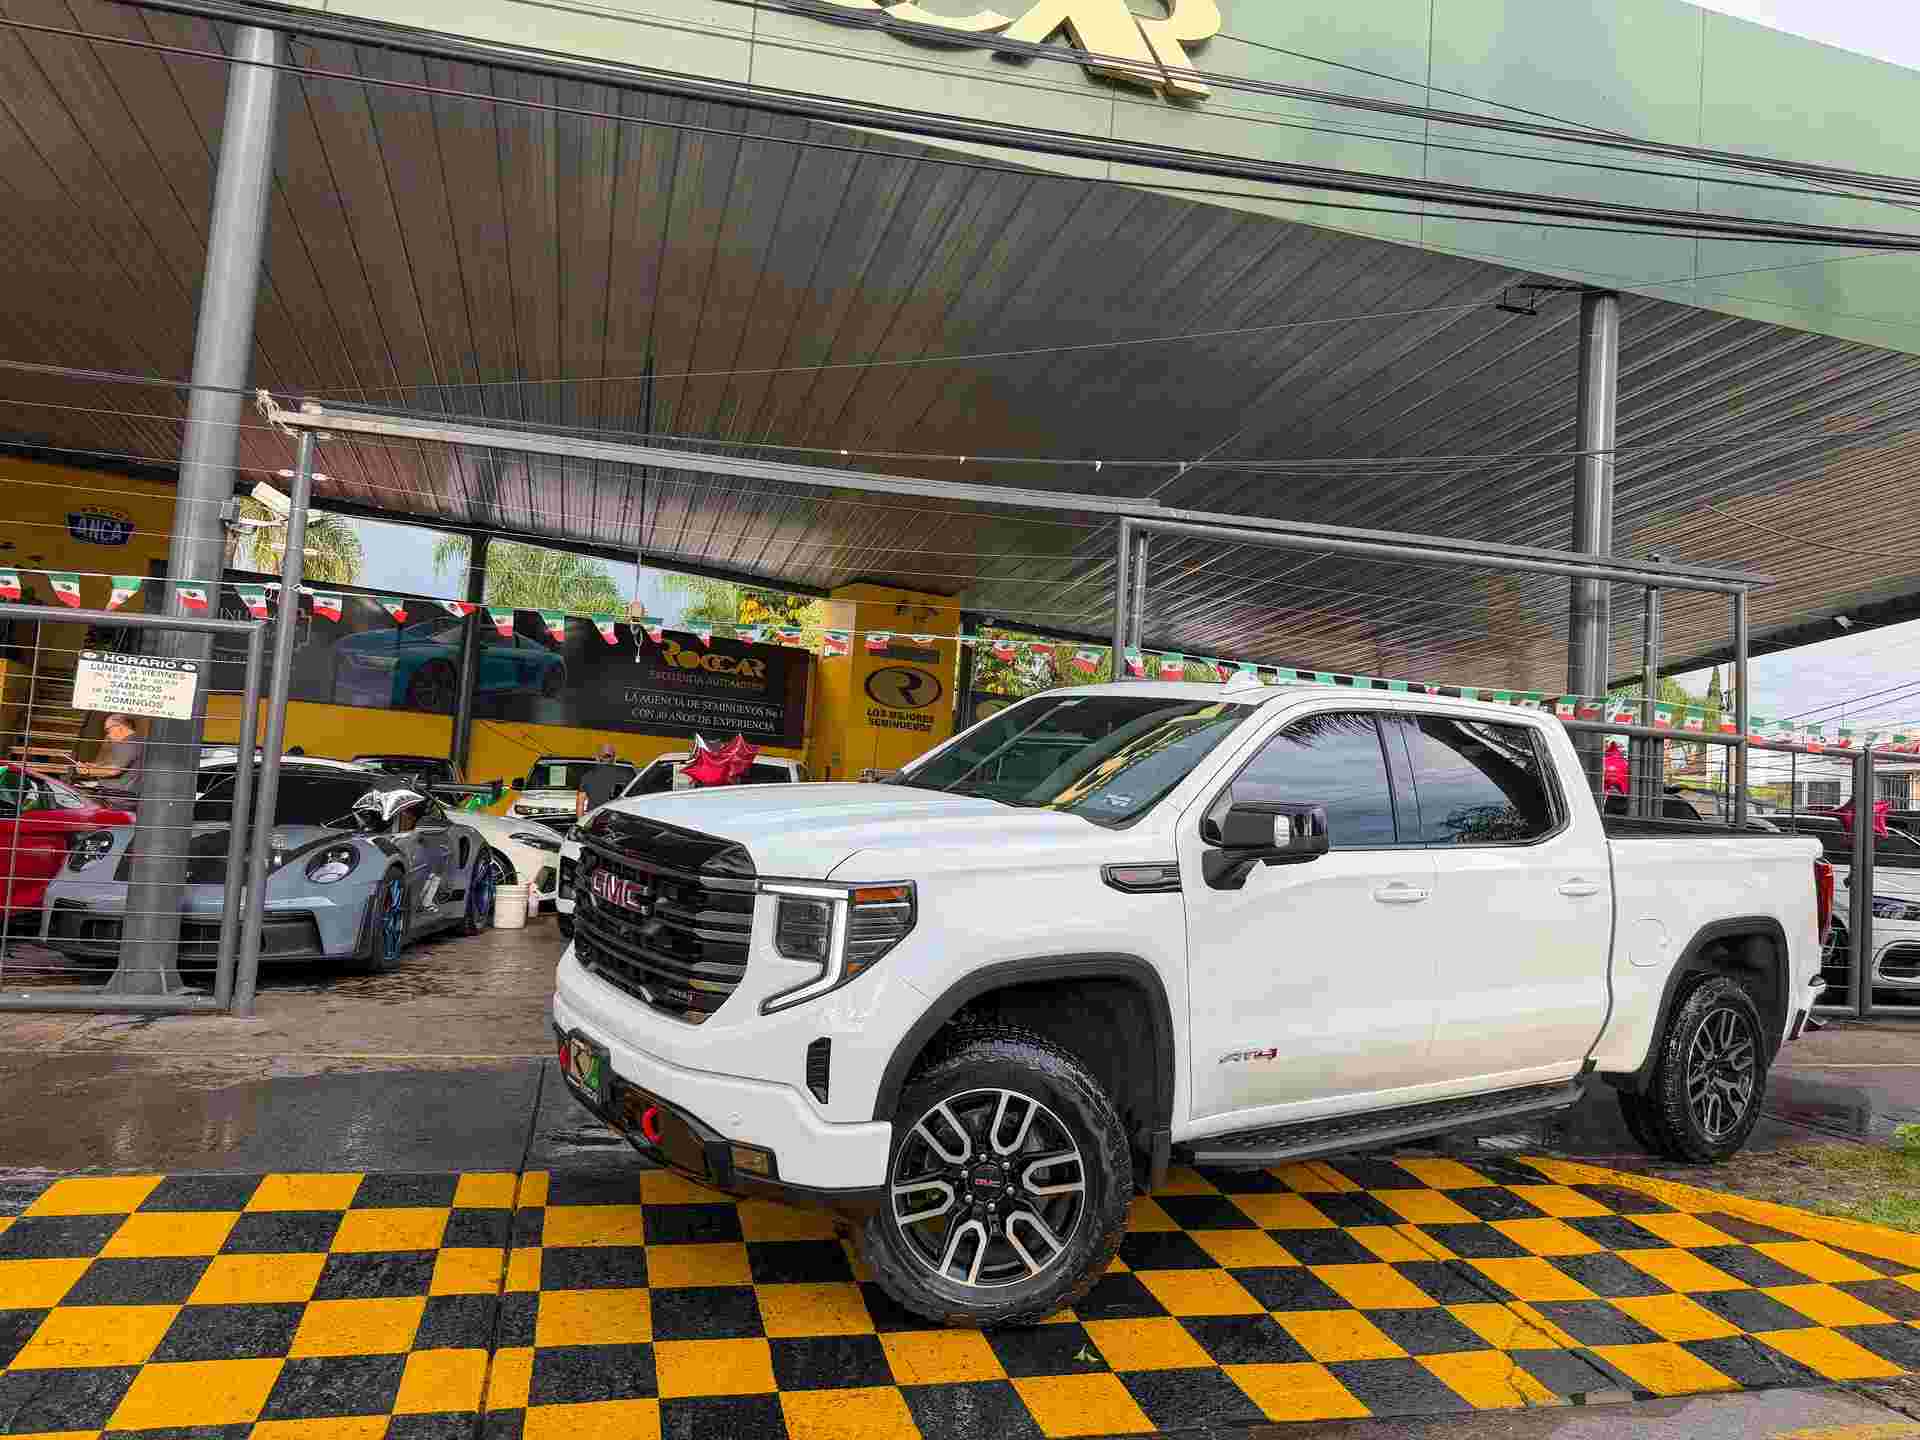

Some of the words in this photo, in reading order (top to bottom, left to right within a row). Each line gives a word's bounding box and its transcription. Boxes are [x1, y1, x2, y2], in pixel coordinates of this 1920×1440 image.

[89, 662, 127, 674] LUNES
[103, 653, 178, 669] HORARIO
[103, 695, 165, 709] DOMINGOS
[632, 707, 653, 720] CON
[592, 871, 648, 915] GMC
